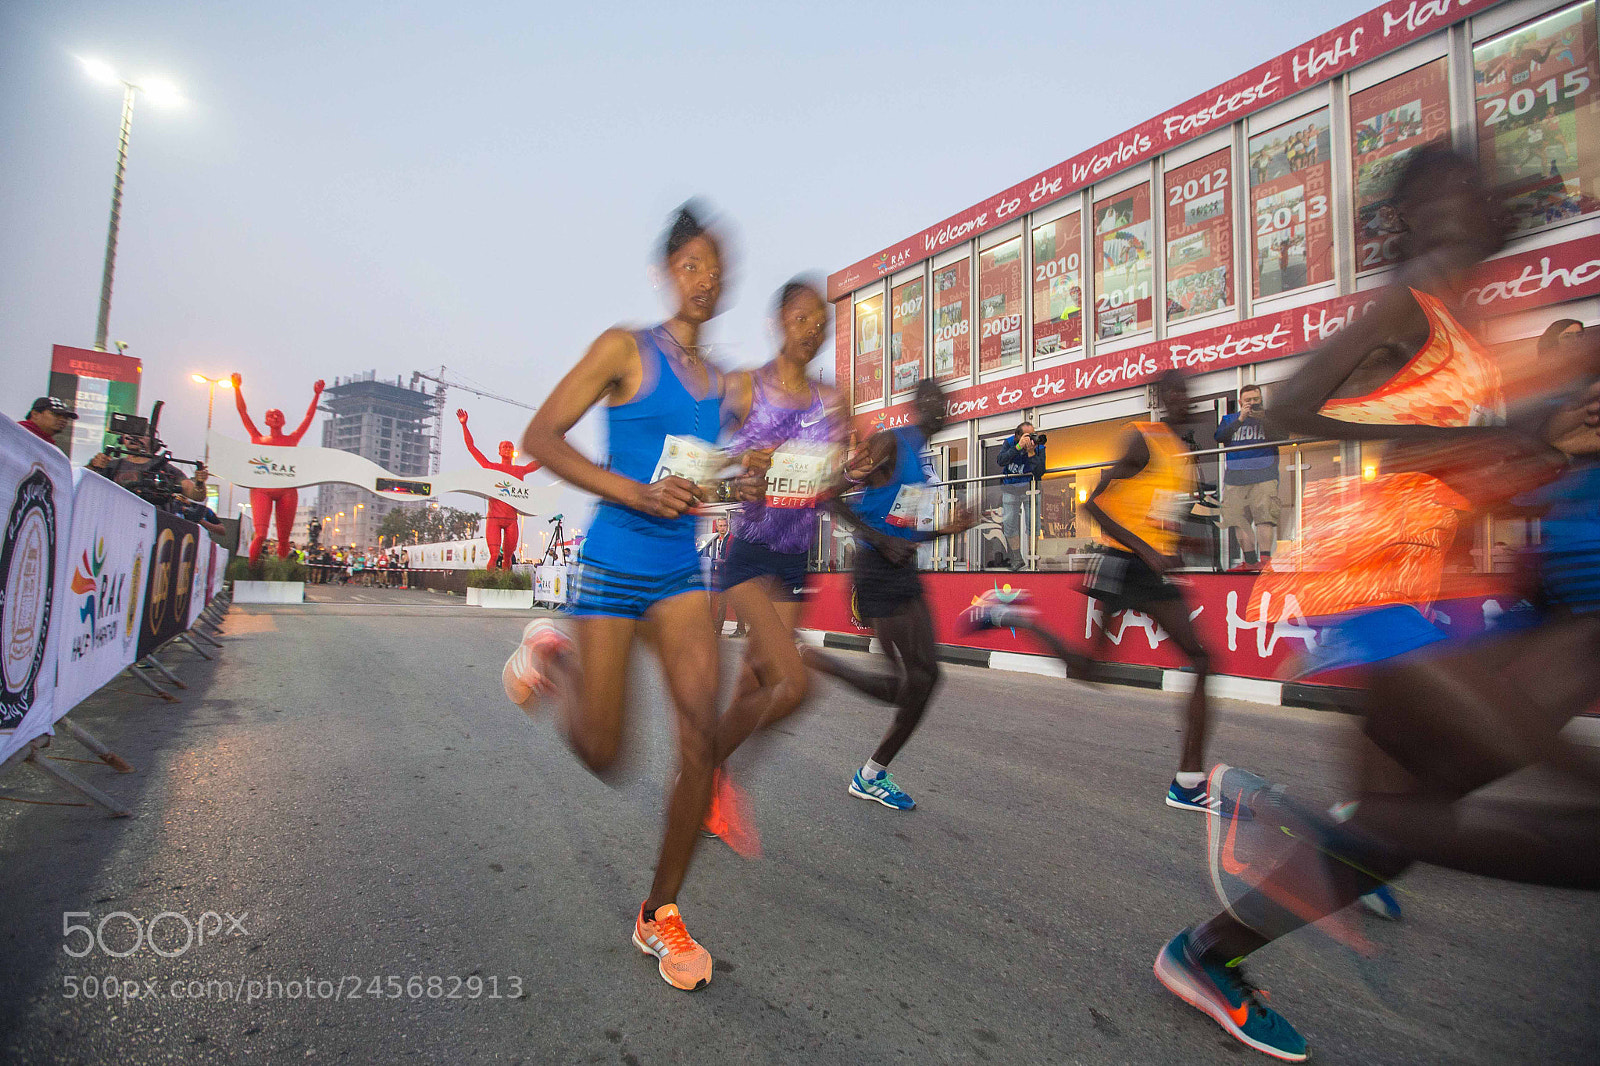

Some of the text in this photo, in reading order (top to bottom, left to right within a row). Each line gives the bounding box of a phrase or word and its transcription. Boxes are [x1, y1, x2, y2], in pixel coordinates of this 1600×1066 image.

[1483, 66, 1591, 127] 2015
[924, 212, 988, 252] Welcome
[996, 197, 1021, 218] to
[1029, 177, 1063, 202] the
[1072, 133, 1152, 184] Worlds
[1162, 71, 1281, 140] Fastest
[1292, 27, 1364, 83] Half
[1169, 168, 1229, 206] 2012
[1256, 195, 1328, 236] 2013
[891, 248, 911, 265] RAK
[1036, 253, 1079, 282] 2010
[893, 296, 922, 319] 2007
[1098, 280, 1149, 312] 2011
[935, 320, 968, 342] 2008
[982, 313, 1021, 338] 2009
[945, 396, 988, 418] lcome
[997, 386, 1022, 405] to
[1031, 373, 1065, 398] the
[1075, 354, 1157, 389] Worlds
[1169, 323, 1290, 369] Fastest
[889, 413, 909, 427] RAK
[1231, 424, 1266, 441] MEDIA
[271, 463, 296, 473] RAK
[511, 486, 529, 495] RAK
[766, 476, 817, 495] HELEN
[97, 573, 126, 619] RAK
